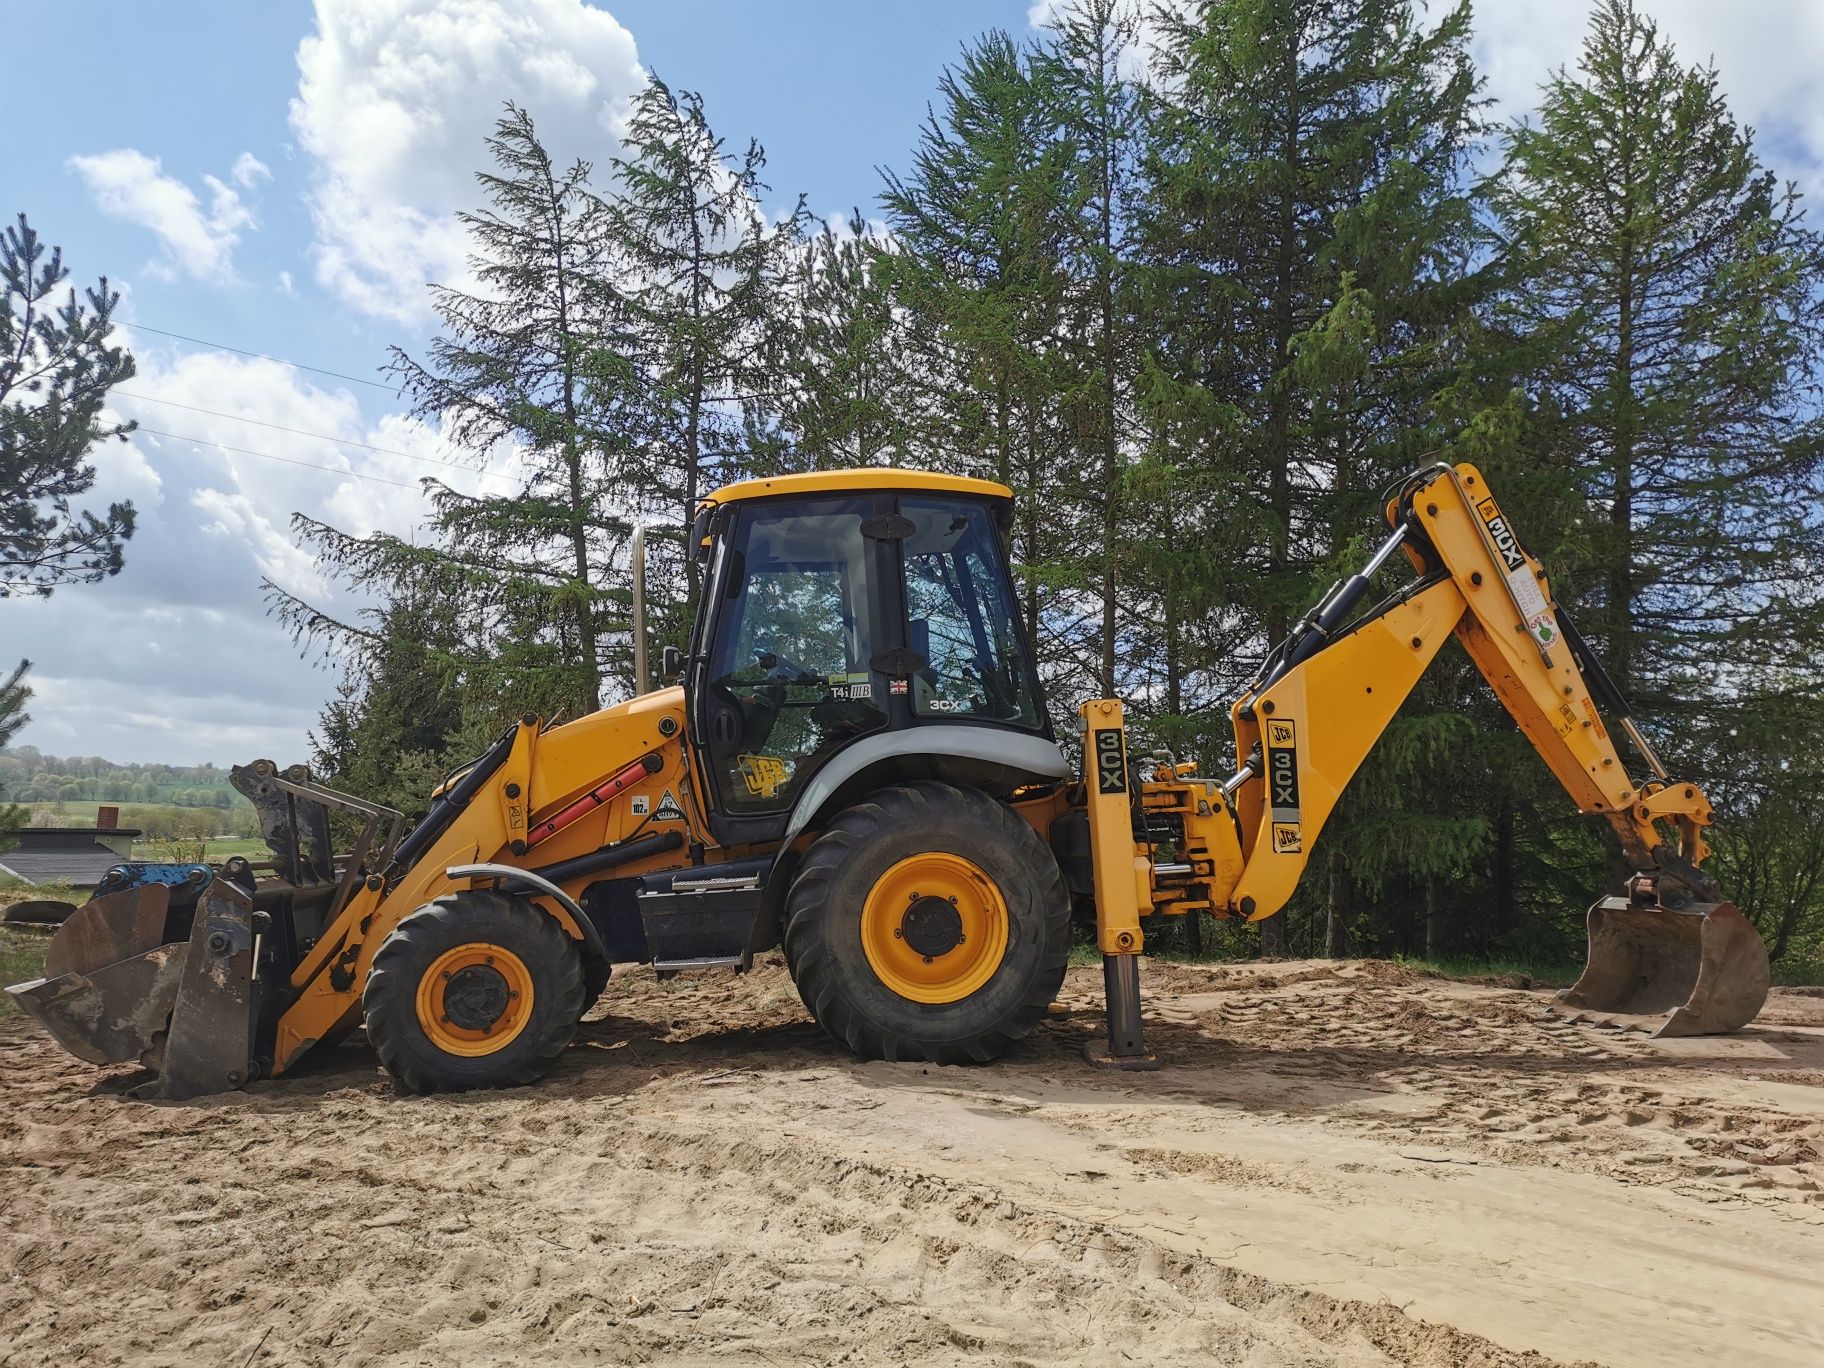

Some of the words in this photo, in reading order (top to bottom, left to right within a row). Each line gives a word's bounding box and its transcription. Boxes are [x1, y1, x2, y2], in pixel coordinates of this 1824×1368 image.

[1488, 517, 1523, 566] 3CX
[831, 687, 849, 698] T4i
[930, 700, 960, 710] 3CX
[1273, 726, 1292, 741] JCB
[1099, 732, 1124, 788] 3CX
[1275, 753, 1295, 803] 3CX
[633, 804, 644, 814] 102
[1280, 829, 1298, 846] JCB
